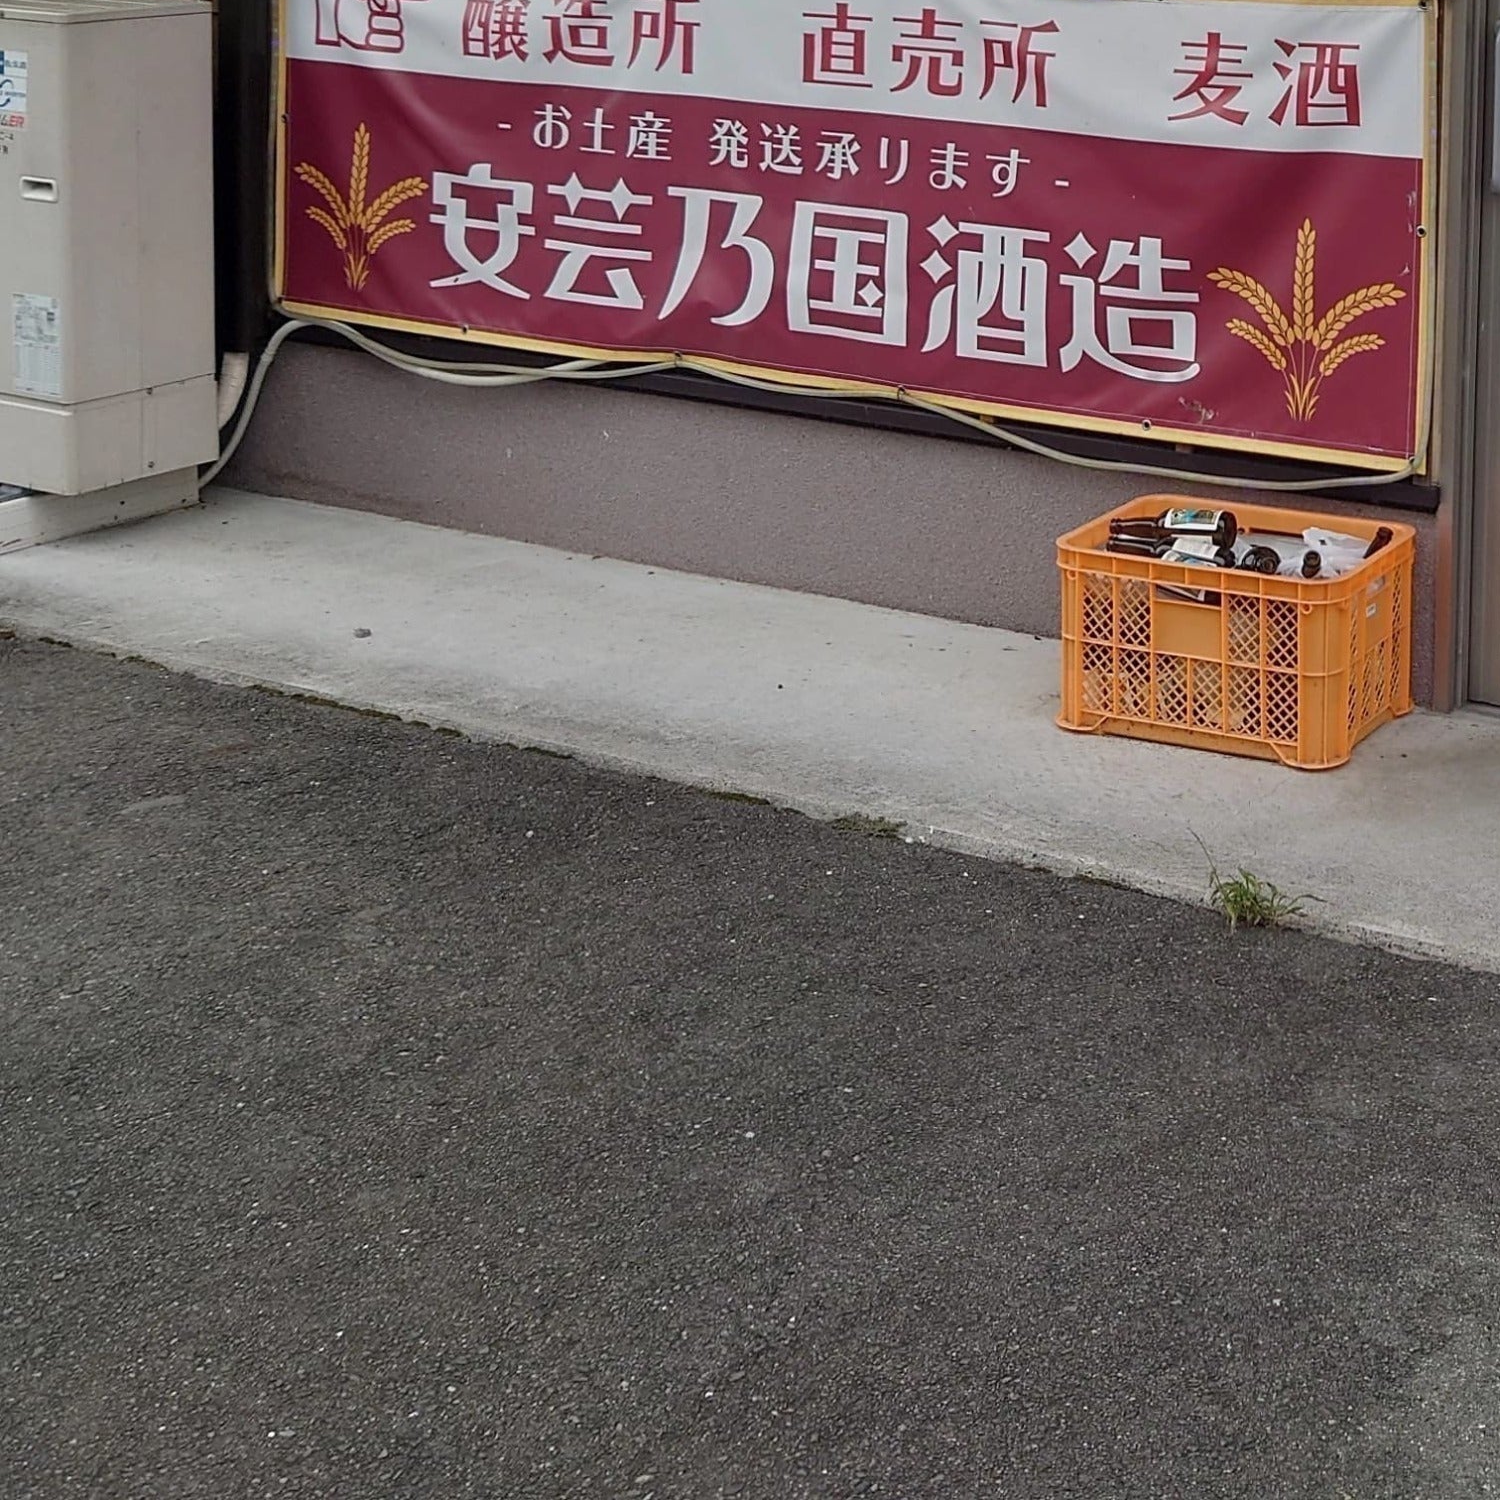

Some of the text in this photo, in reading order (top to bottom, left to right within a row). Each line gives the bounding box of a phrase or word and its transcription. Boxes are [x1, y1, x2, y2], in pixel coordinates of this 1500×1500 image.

[801, 0, 1059, 108] 直売所
[1168, 31, 1362, 129] 麦酒
[531, 102, 1034, 200] お土産 発送承ります
[428, 161, 1201, 385] 安芸乃国酒造
